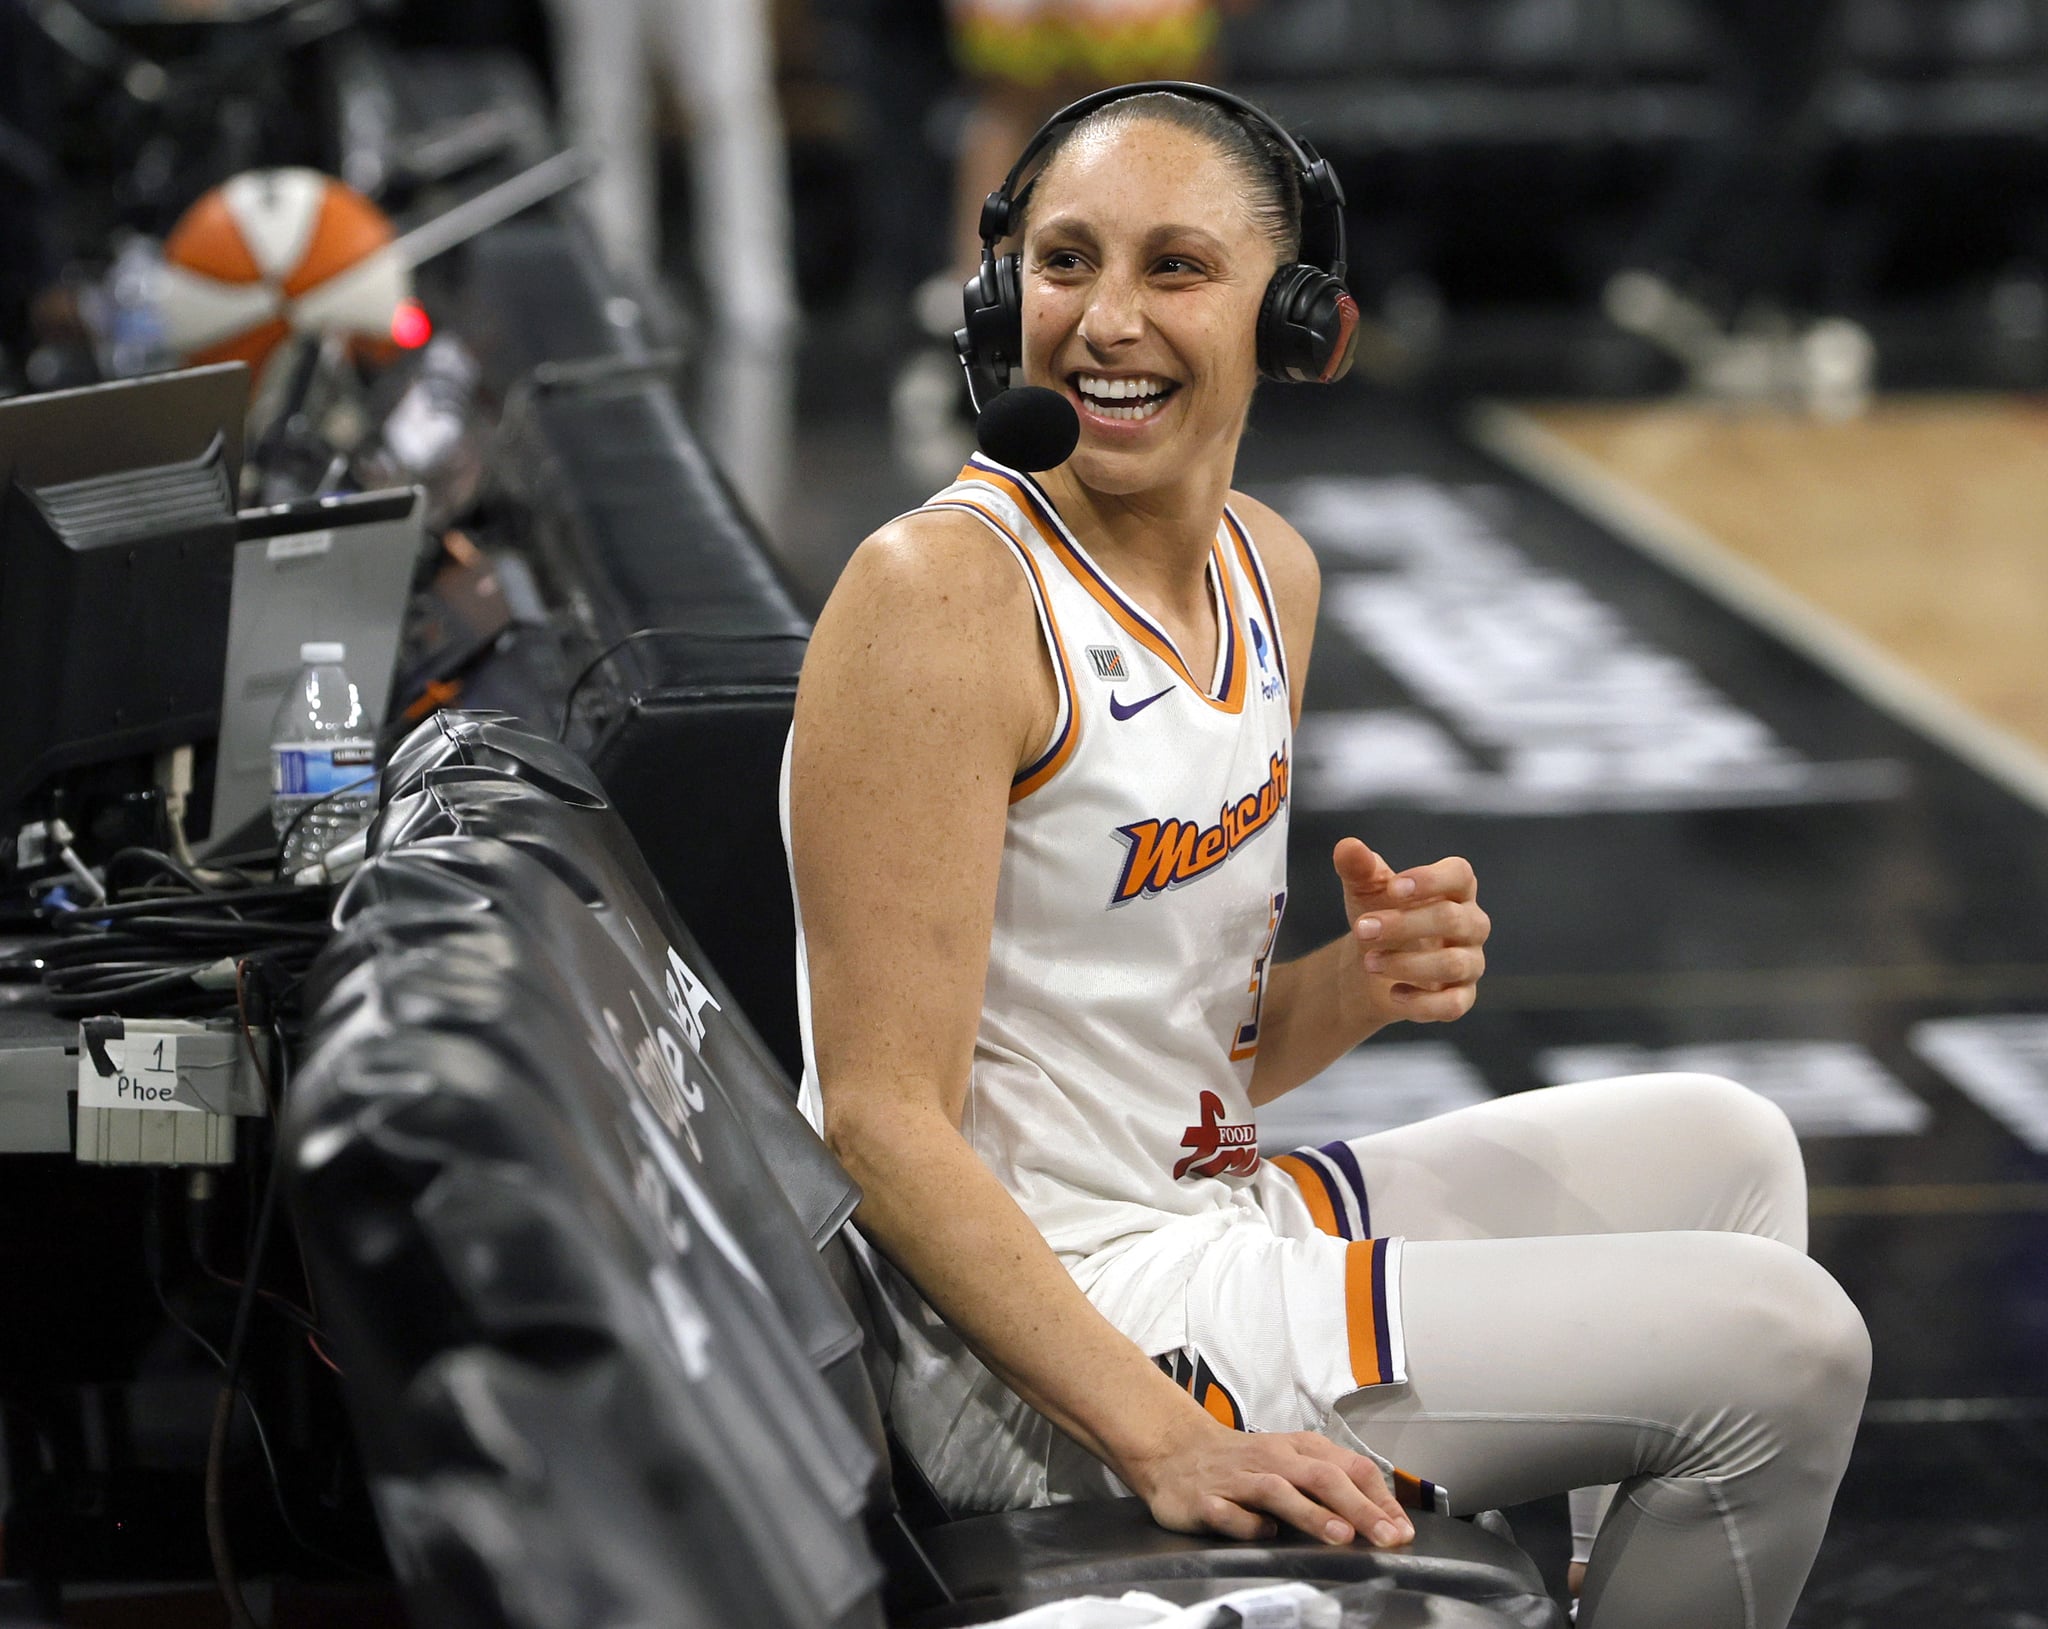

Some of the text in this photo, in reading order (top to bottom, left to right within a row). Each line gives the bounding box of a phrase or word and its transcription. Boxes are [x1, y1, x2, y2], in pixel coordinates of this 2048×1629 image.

[144, 1039, 175, 1073] 1
[117, 1076, 172, 1101] Phoe
[1218, 1126, 1254, 1143] FOOD
